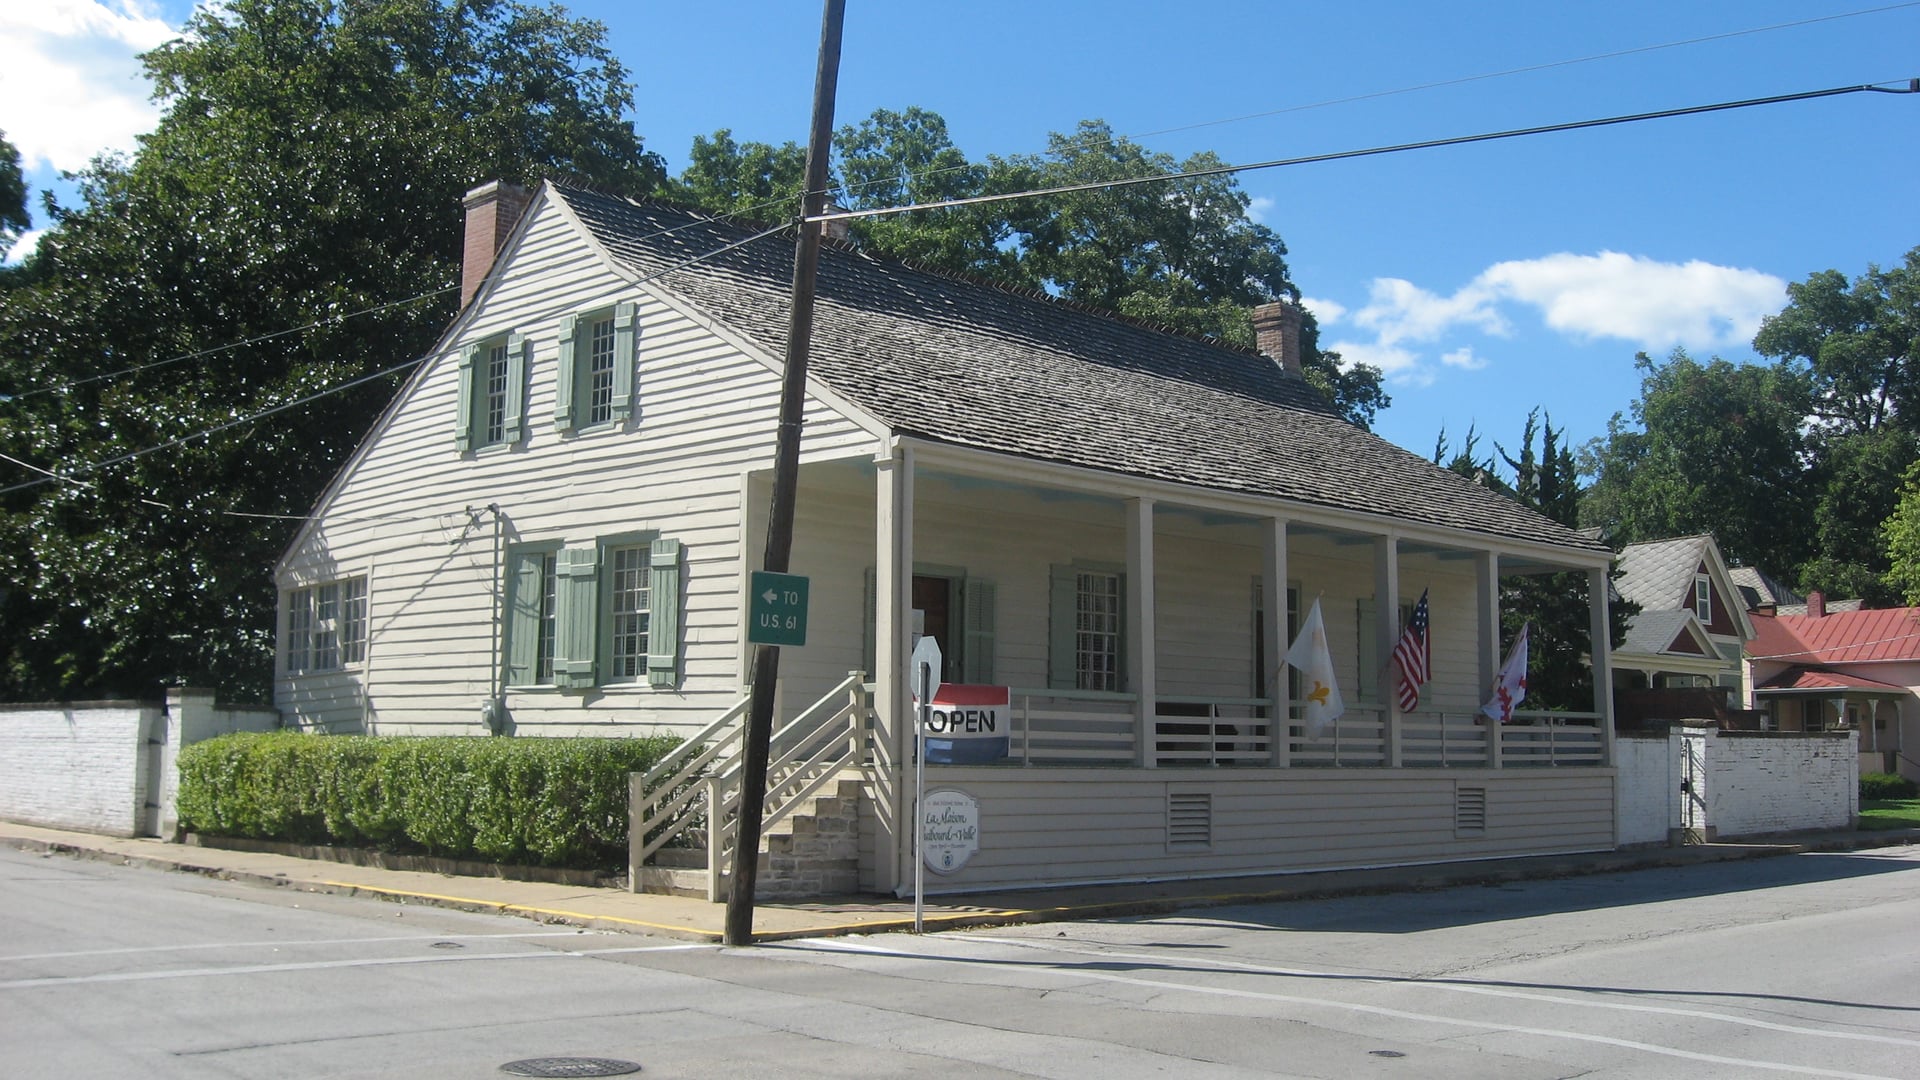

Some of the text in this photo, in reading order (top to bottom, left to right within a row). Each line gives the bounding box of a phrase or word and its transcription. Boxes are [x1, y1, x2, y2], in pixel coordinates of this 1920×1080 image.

[783, 591, 798, 605] TO
[760, 613, 797, 630] U.S. 61
[928, 709, 996, 733] OPEN
[925, 806, 967, 824] La Maison
